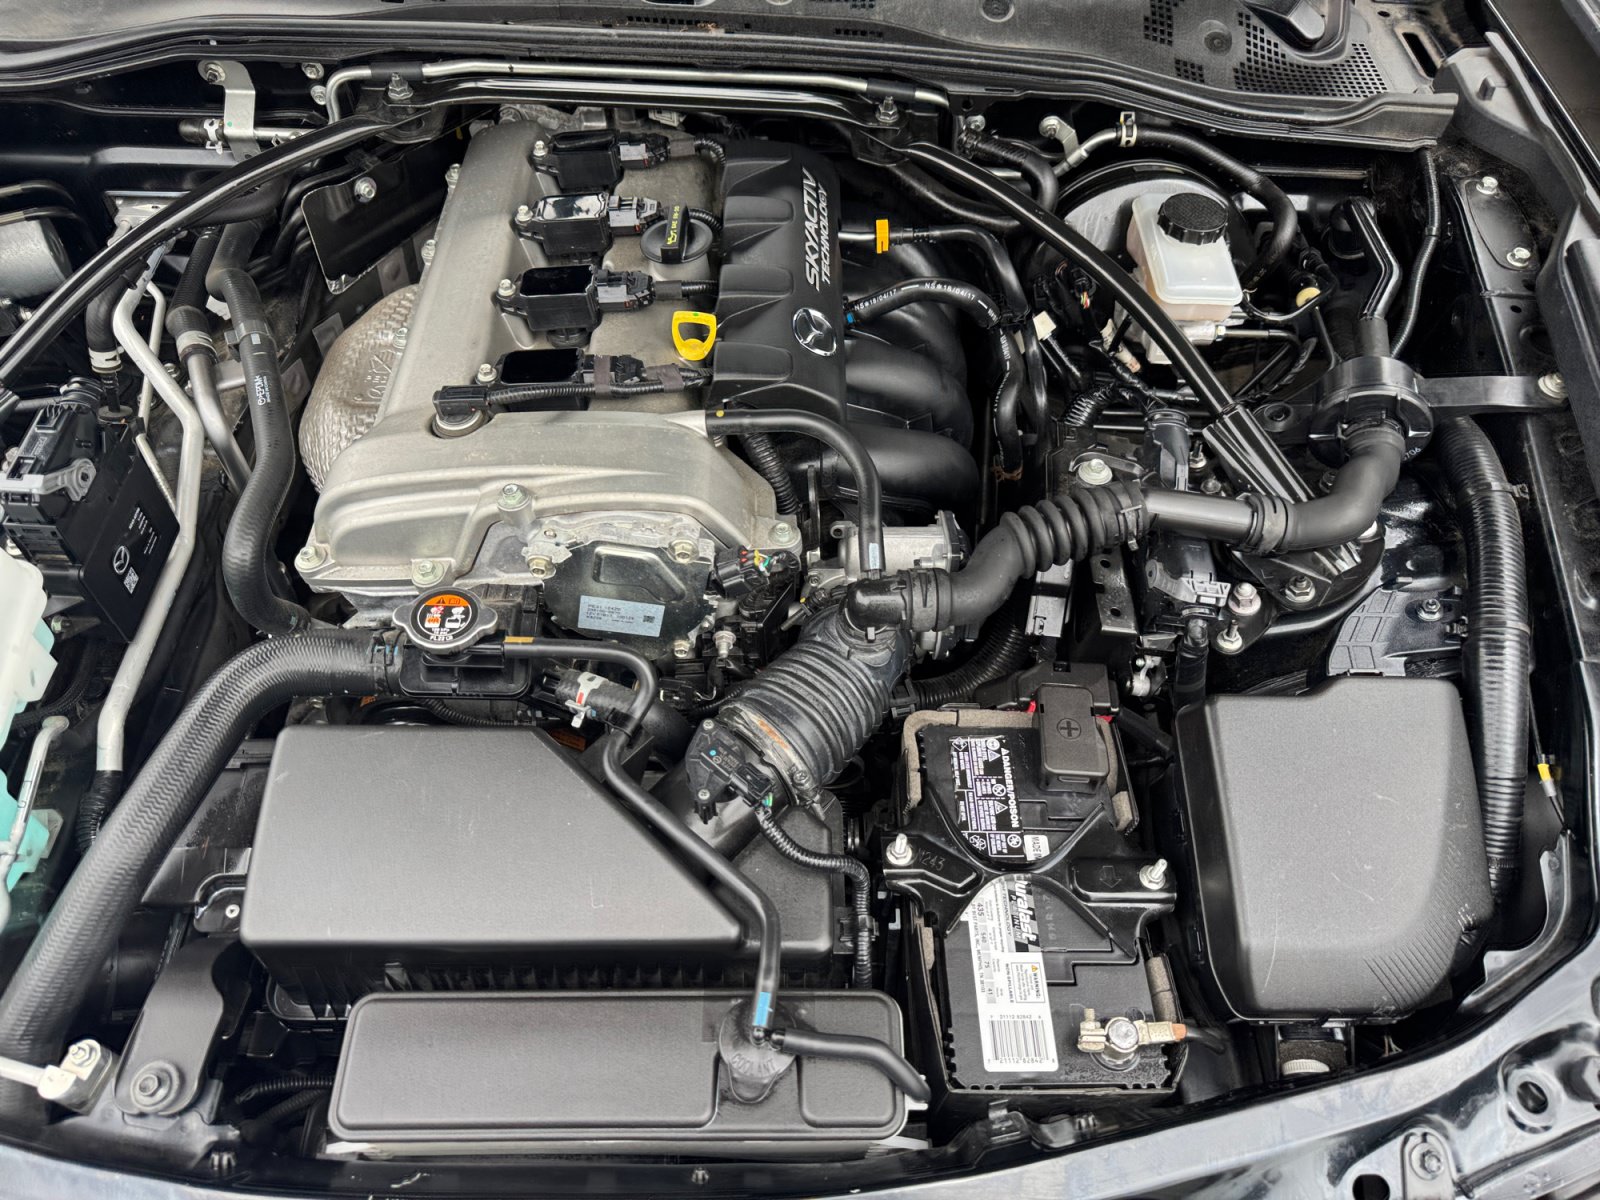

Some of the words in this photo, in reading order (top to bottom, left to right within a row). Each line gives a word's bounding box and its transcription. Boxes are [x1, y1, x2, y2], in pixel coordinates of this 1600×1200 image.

[802, 167, 820, 292] SKYACTIV
[818, 182, 831, 285] TECHNOLOGY
[1002, 756, 1019, 827] DANGER/POISON
[1031, 837, 1041, 853] MADE
[1003, 893, 1012, 936] TECHNOLOGY
[1010, 894, 1021, 939] PLATINUM
